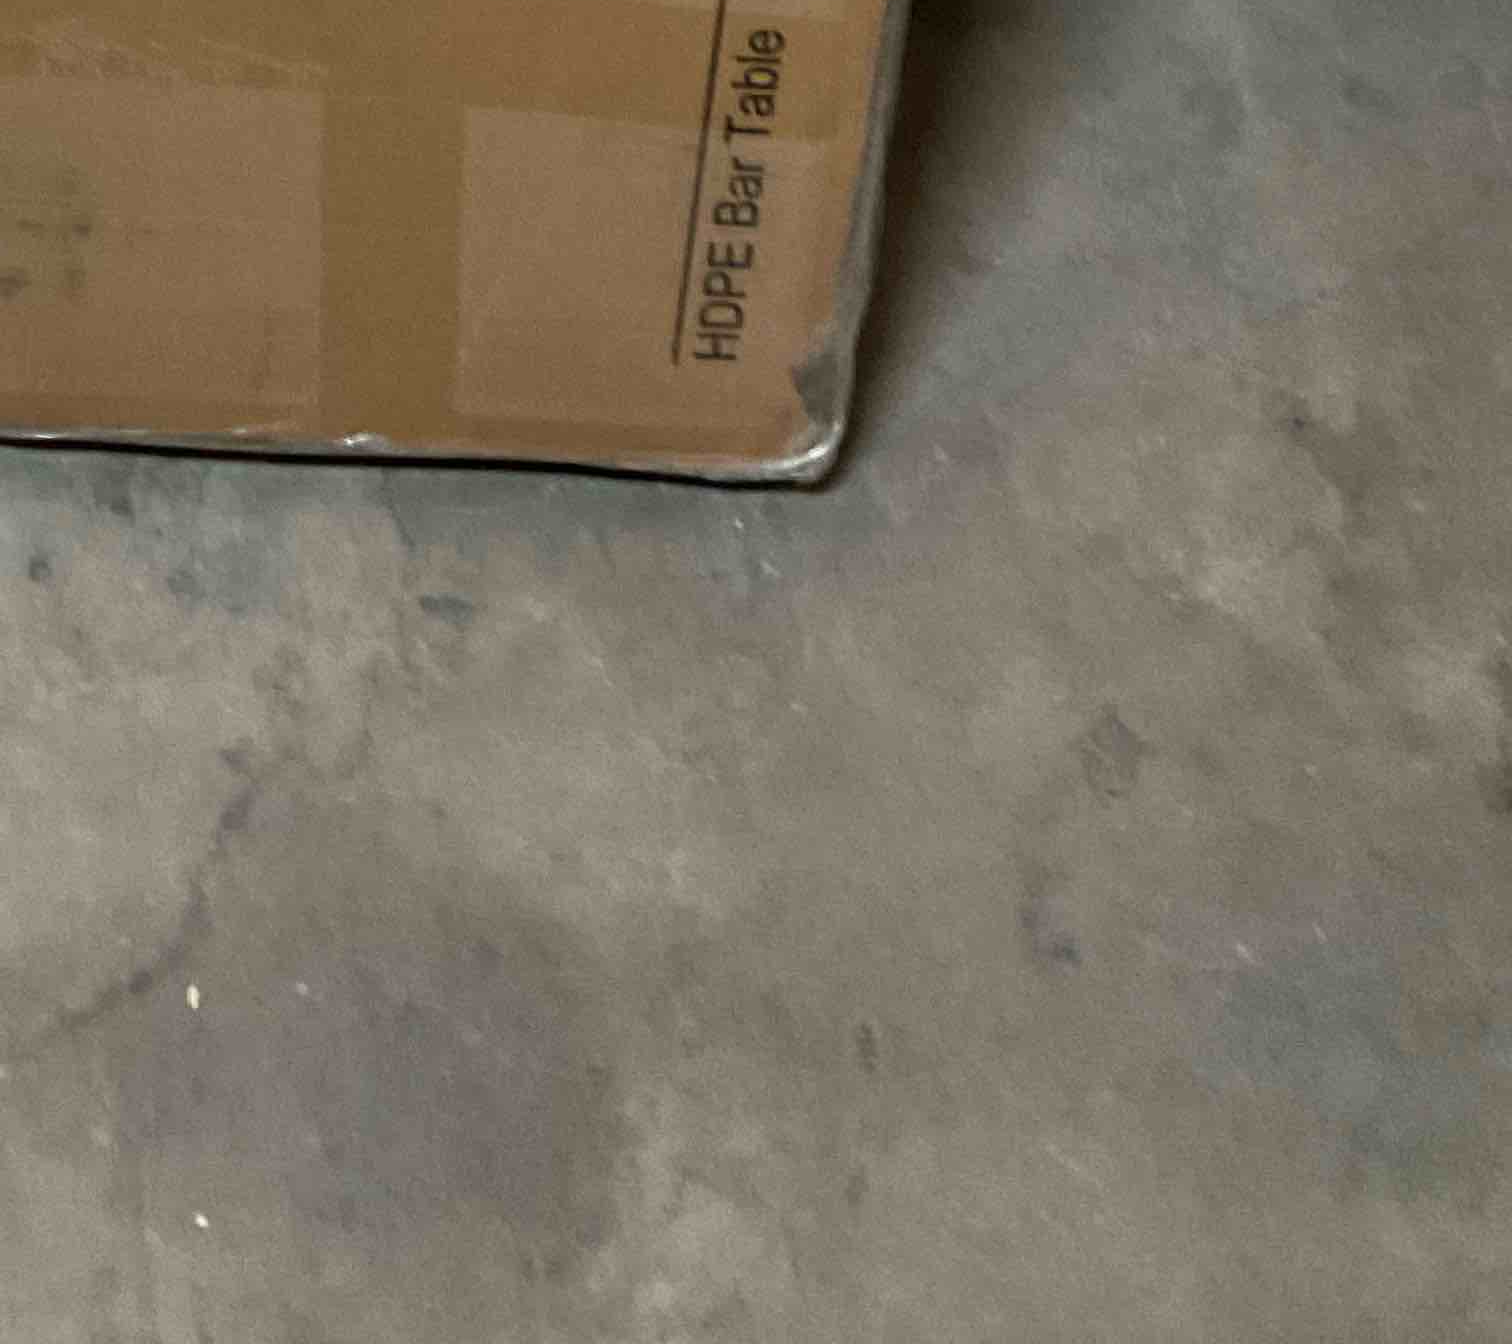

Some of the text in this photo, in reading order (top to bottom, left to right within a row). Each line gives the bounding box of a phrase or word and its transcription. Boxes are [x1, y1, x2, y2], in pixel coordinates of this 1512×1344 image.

[693, 28, 786, 363] HDPE Bar Table
